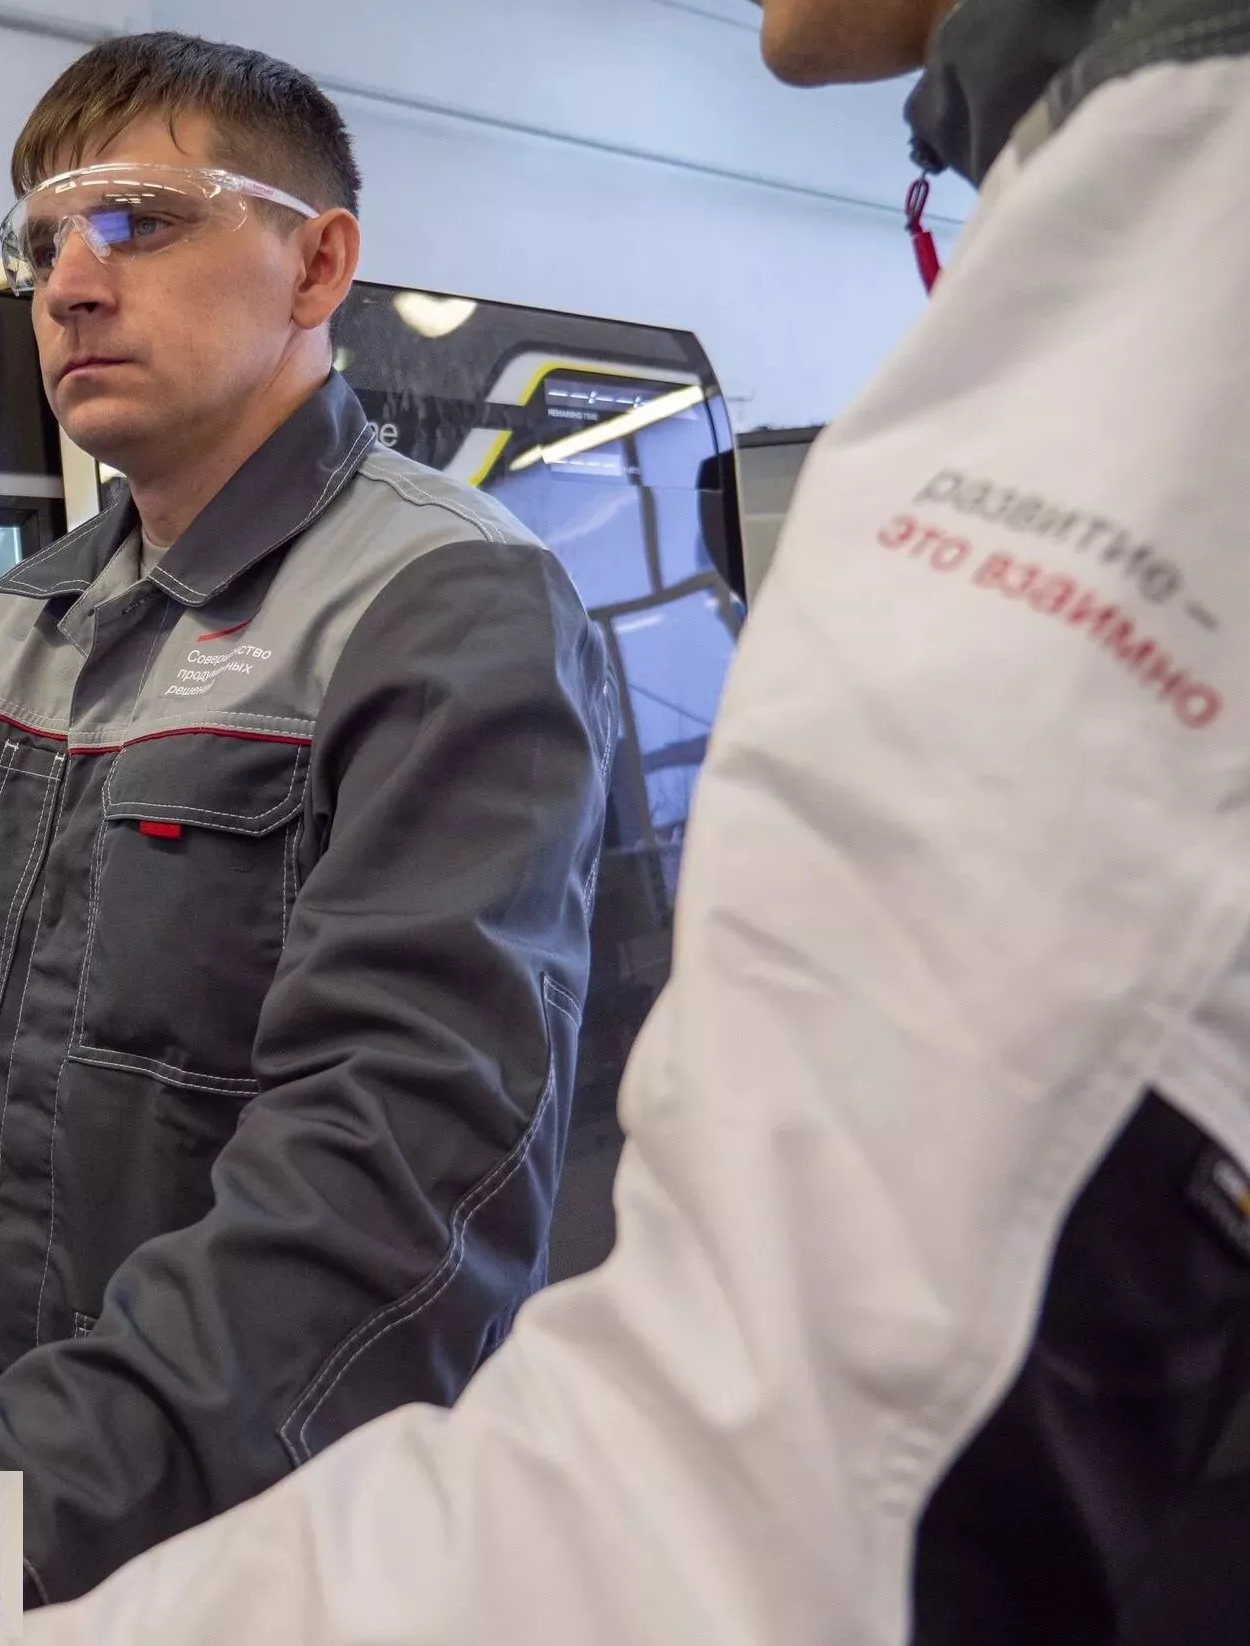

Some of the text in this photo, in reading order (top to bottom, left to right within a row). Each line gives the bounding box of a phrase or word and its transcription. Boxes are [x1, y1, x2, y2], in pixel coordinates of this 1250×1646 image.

[910, 468, 1184, 605] развитие
[187, 645, 272, 666] Соверство
[876, 514, 1223, 730] это взаимно
[177, 661, 254, 682] продуных
